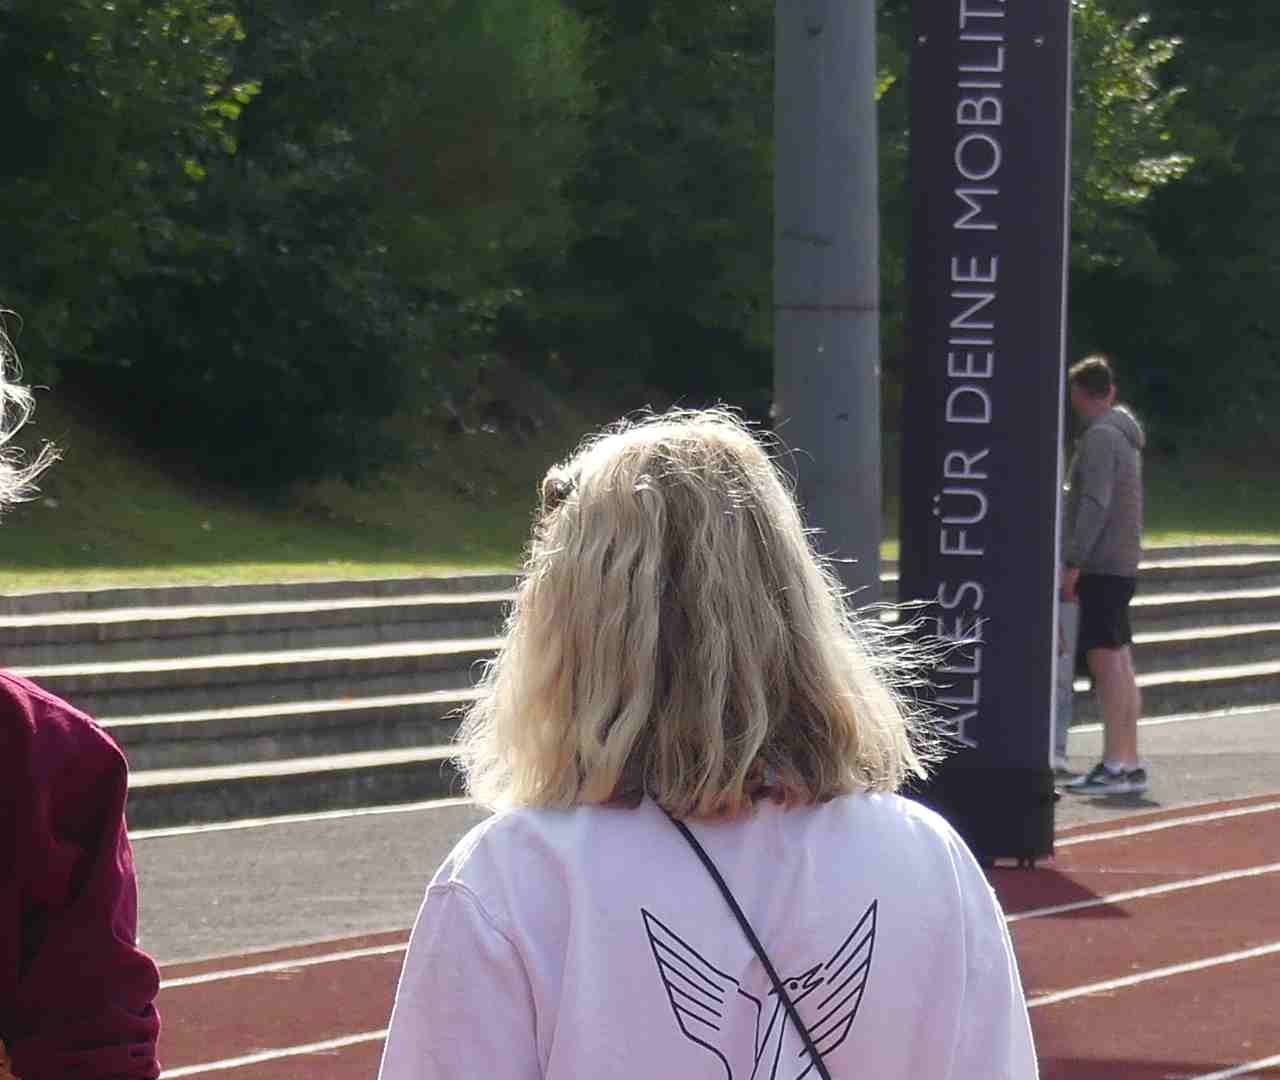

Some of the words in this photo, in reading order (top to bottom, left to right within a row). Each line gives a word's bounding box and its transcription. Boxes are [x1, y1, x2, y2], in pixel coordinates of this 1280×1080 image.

[951, 0, 1005, 230] MOBILIT
[945, 256, 998, 423] DEINE
[932, 448, 989, 555] FÜR
[934, 581, 983, 748] ALLES
